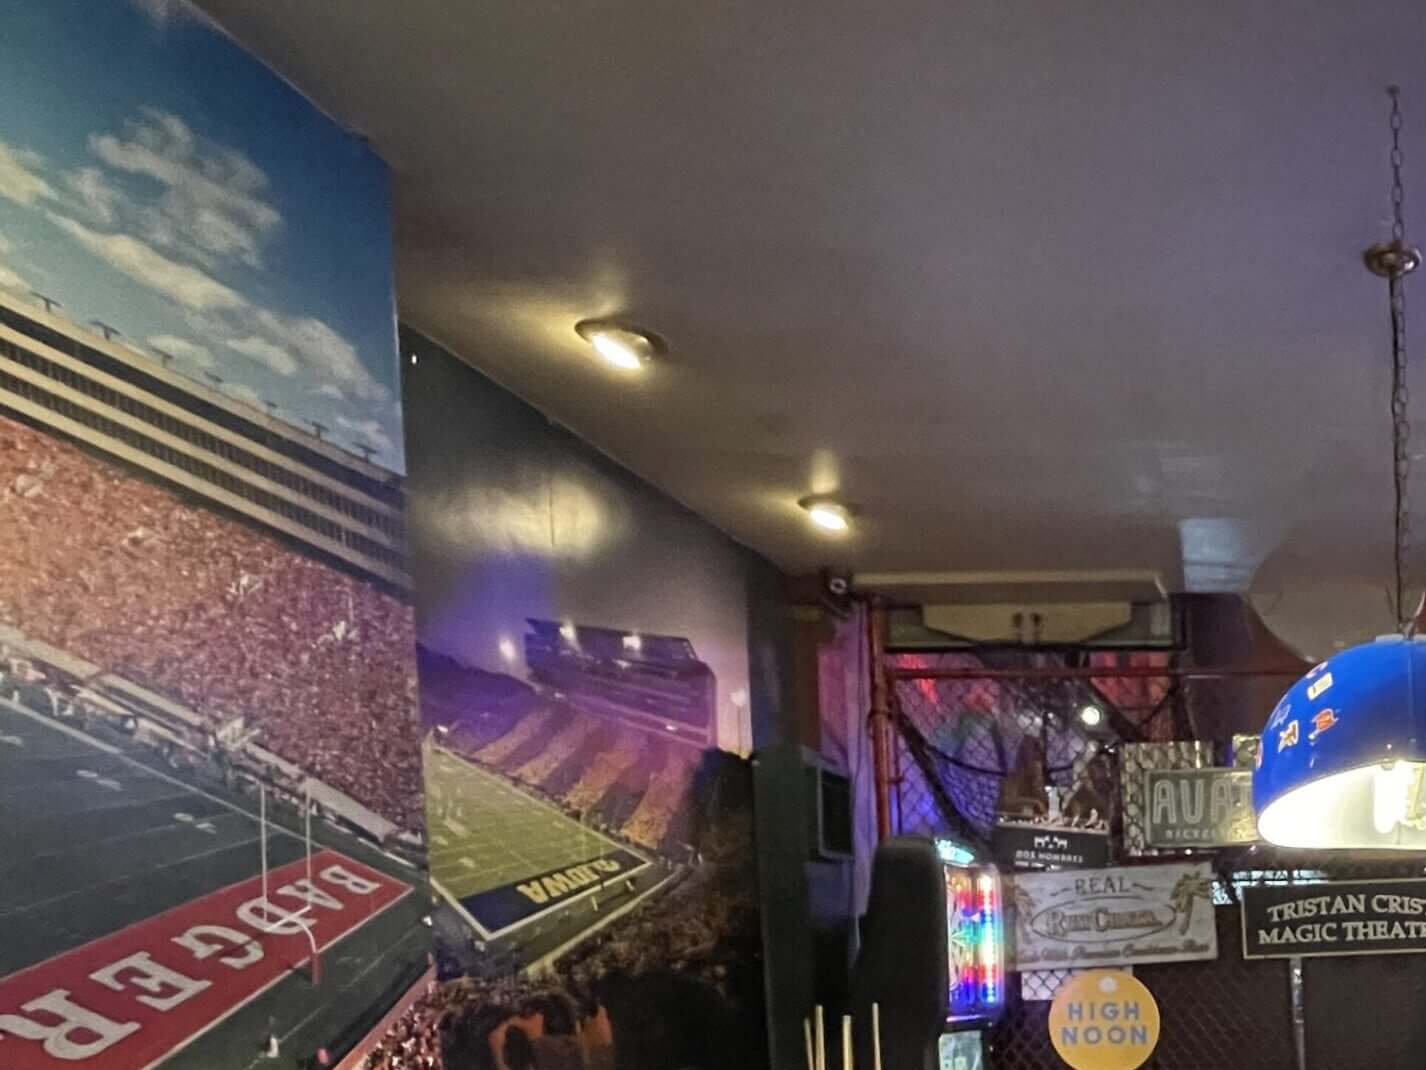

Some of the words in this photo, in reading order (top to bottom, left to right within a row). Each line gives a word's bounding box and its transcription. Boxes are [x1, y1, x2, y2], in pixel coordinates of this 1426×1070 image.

[1152, 778, 1254, 825] AVA
[1074, 876, 1131, 896] REAL
[1266, 894, 1366, 923] TRISTAN
[1258, 923, 1337, 944] MAGIC
[1067, 1002, 1140, 1021] HIGH
[1061, 1026, 1147, 1045] NOON
